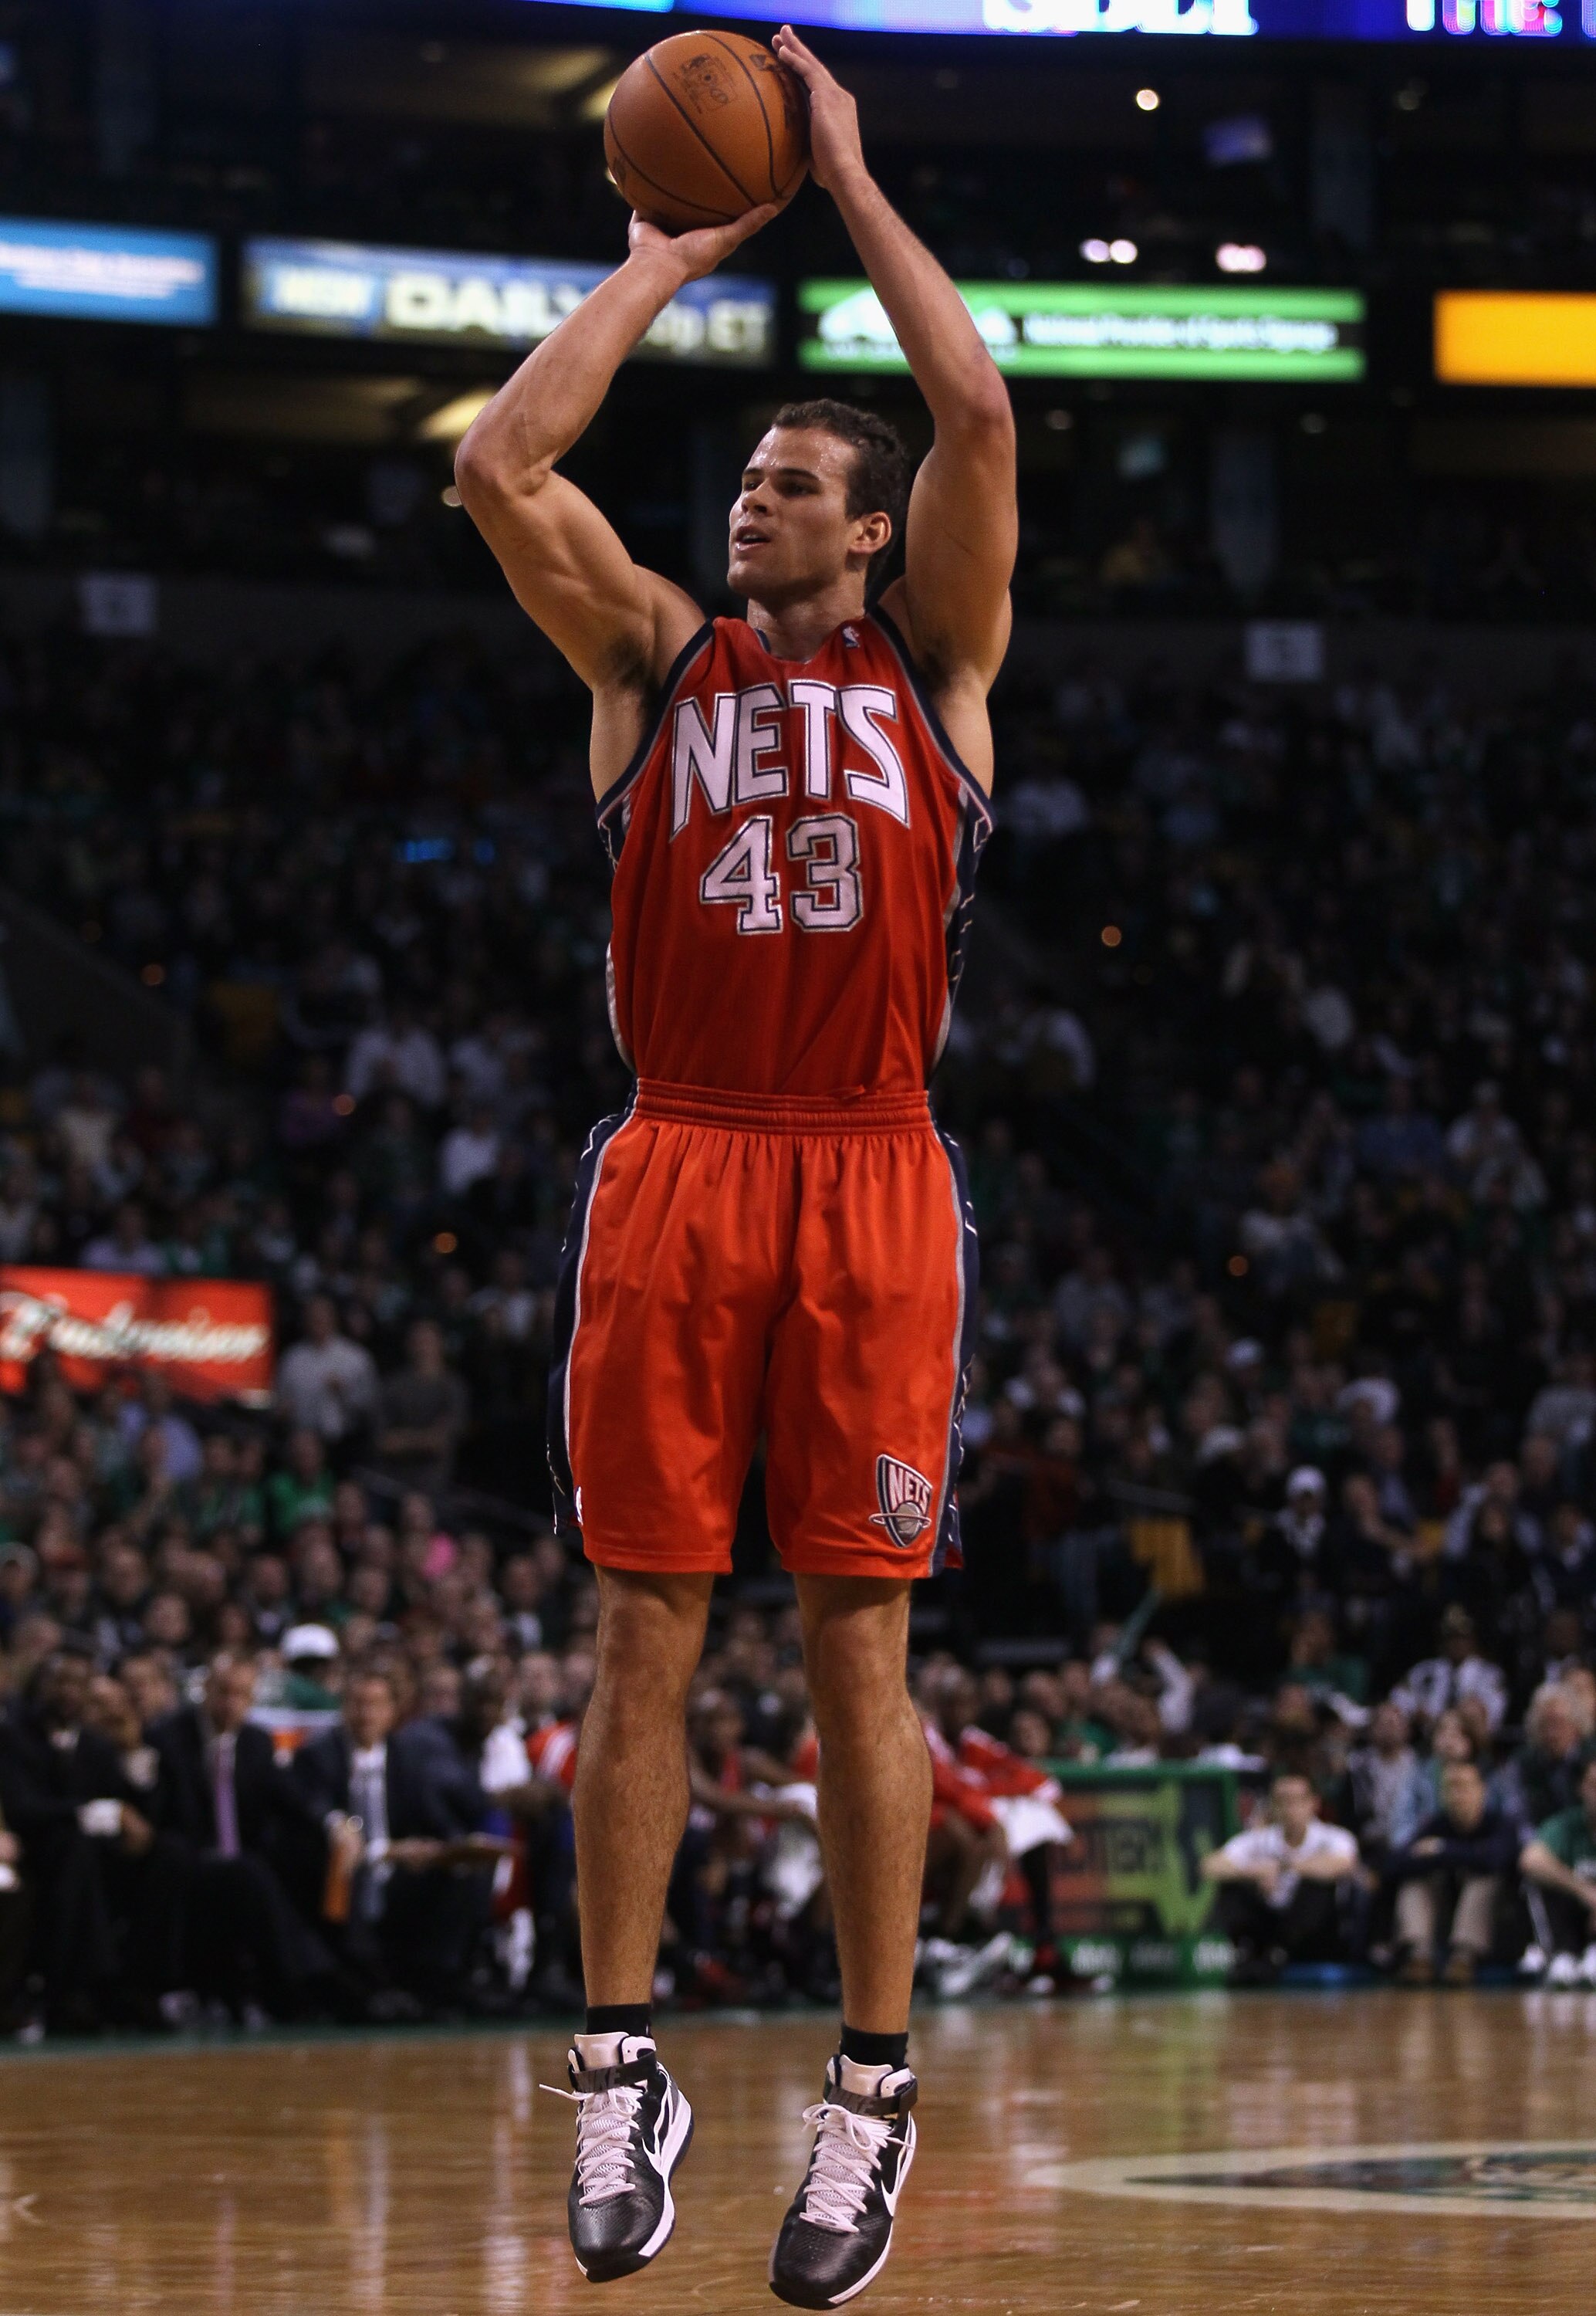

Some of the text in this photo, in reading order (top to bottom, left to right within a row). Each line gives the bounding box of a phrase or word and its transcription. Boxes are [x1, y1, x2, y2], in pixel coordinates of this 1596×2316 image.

[671, 679, 911, 842] NETS
[700, 814, 863, 935] 43
[889, 1464, 930, 1515] NETS
